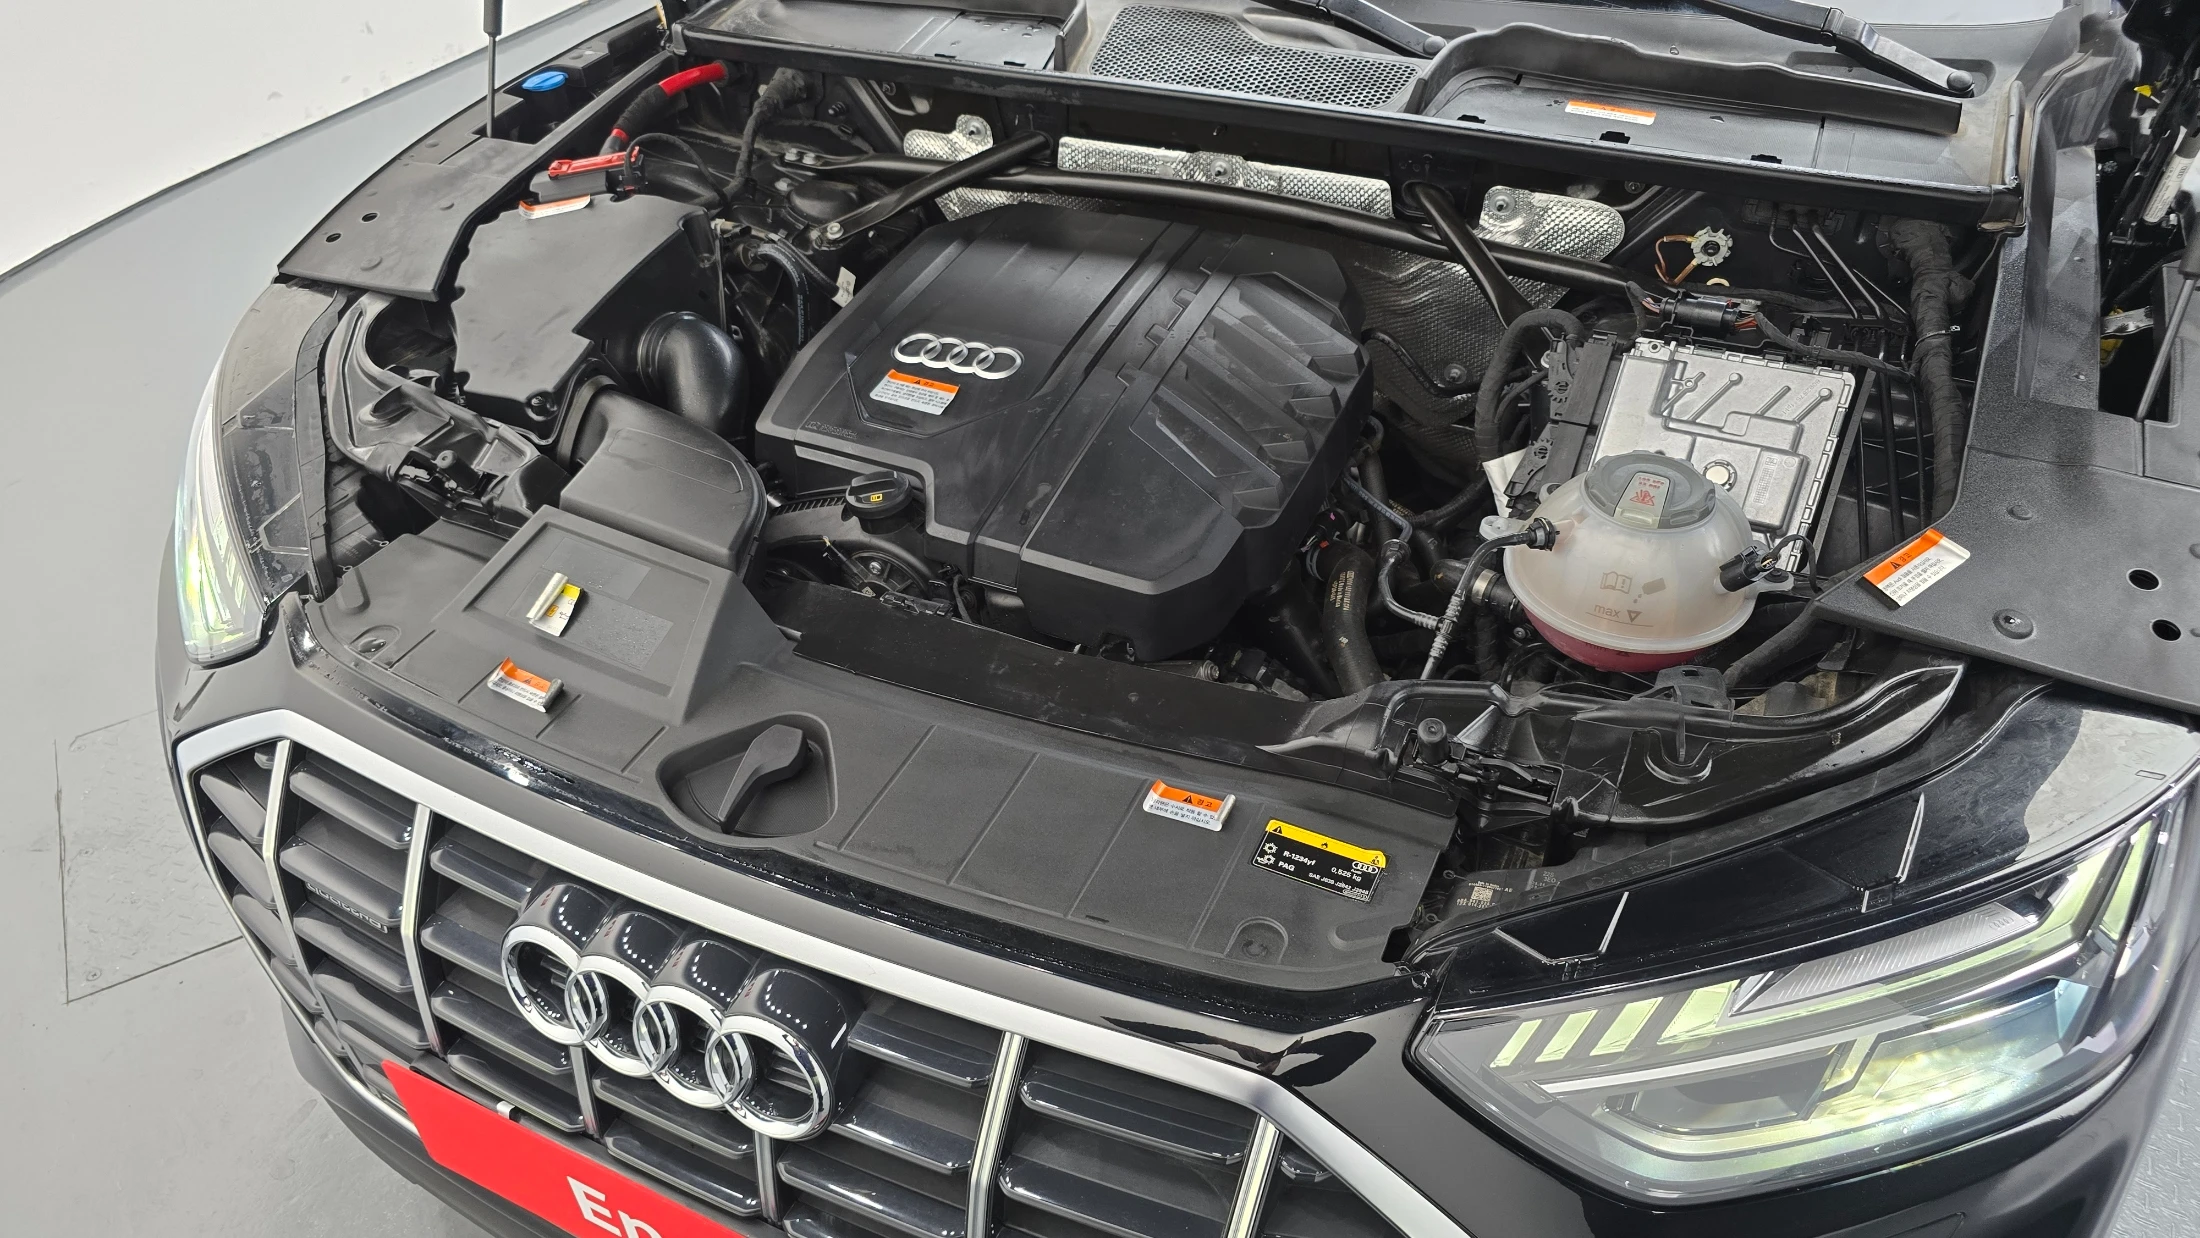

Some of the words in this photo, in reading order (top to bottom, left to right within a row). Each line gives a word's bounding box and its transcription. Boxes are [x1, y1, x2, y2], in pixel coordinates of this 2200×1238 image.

[1594, 604, 1621, 618] max
[1196, 798, 1213, 808] 경고
[1283, 850, 1316, 866] R-1234yf
[1278, 861, 1296, 872] PAG
[1308, 872, 1320, 880] SAE
[1331, 866, 1352, 878] 0,525
[1352, 873, 1362, 882] kg
